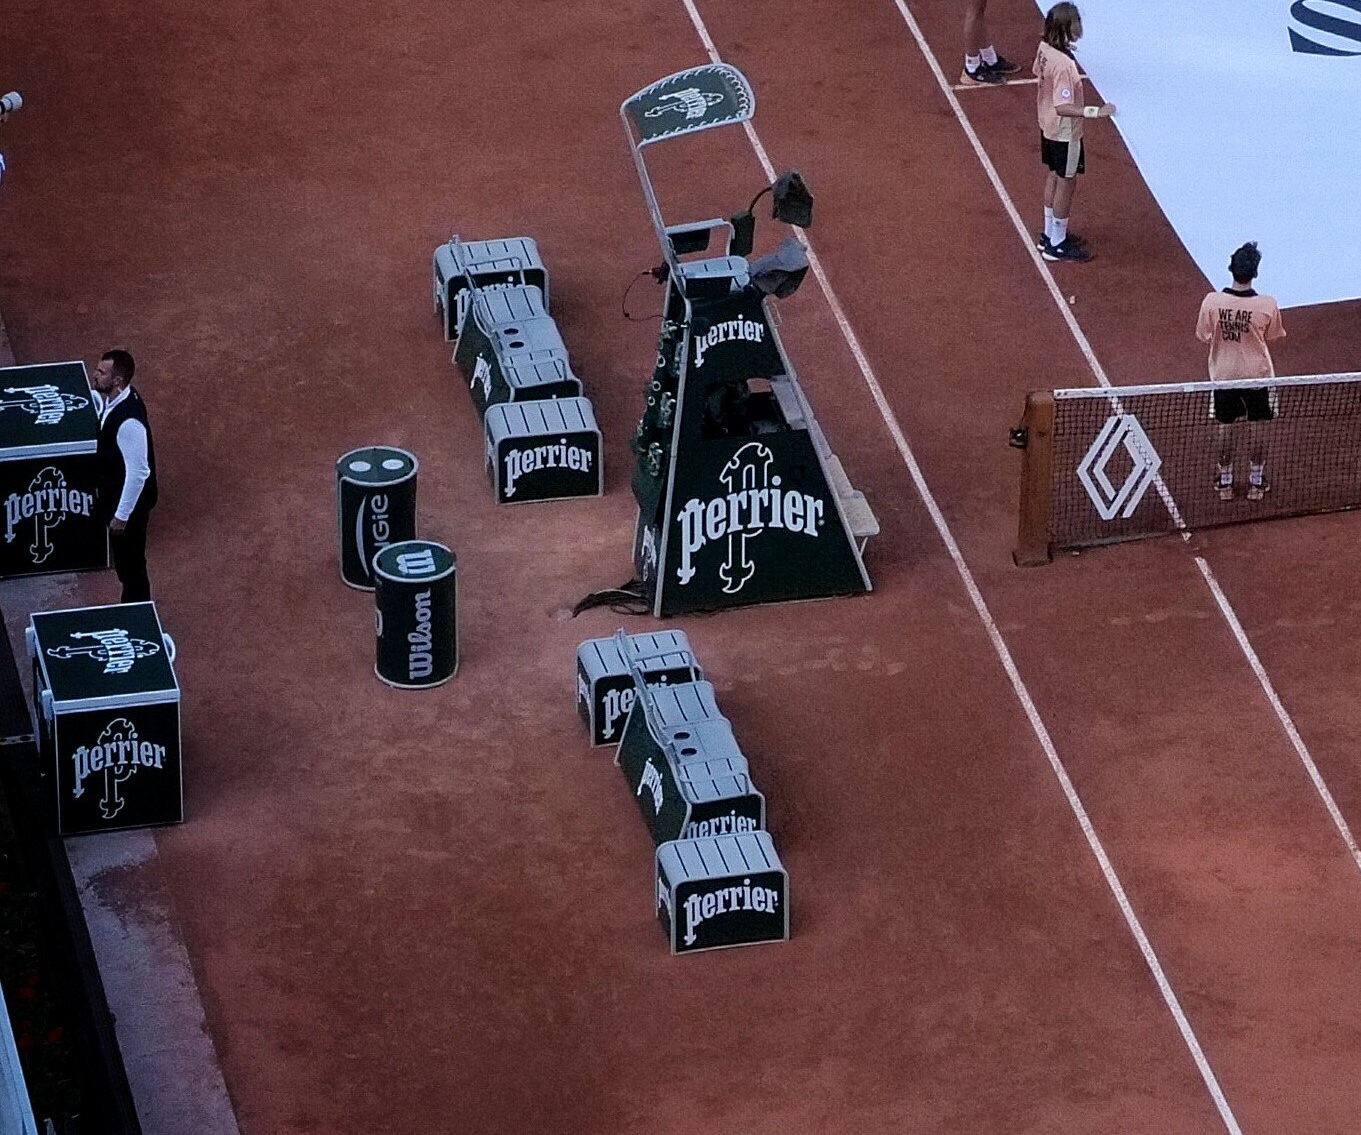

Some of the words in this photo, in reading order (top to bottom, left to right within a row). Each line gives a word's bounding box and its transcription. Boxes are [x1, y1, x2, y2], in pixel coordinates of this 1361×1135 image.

[694, 314, 764, 368] perrier
[1218, 307, 1232, 321] WE
[1236, 309, 1253, 324] ARE
[1218, 319, 1250, 333] TENNIS
[504, 438, 592, 498] perrier
[4, 481, 94, 544] perrier
[676, 475, 824, 586] perrier
[407, 587, 433, 681] Wilson
[72, 732, 167, 799] perrier
[682, 878, 779, 947] perrier
